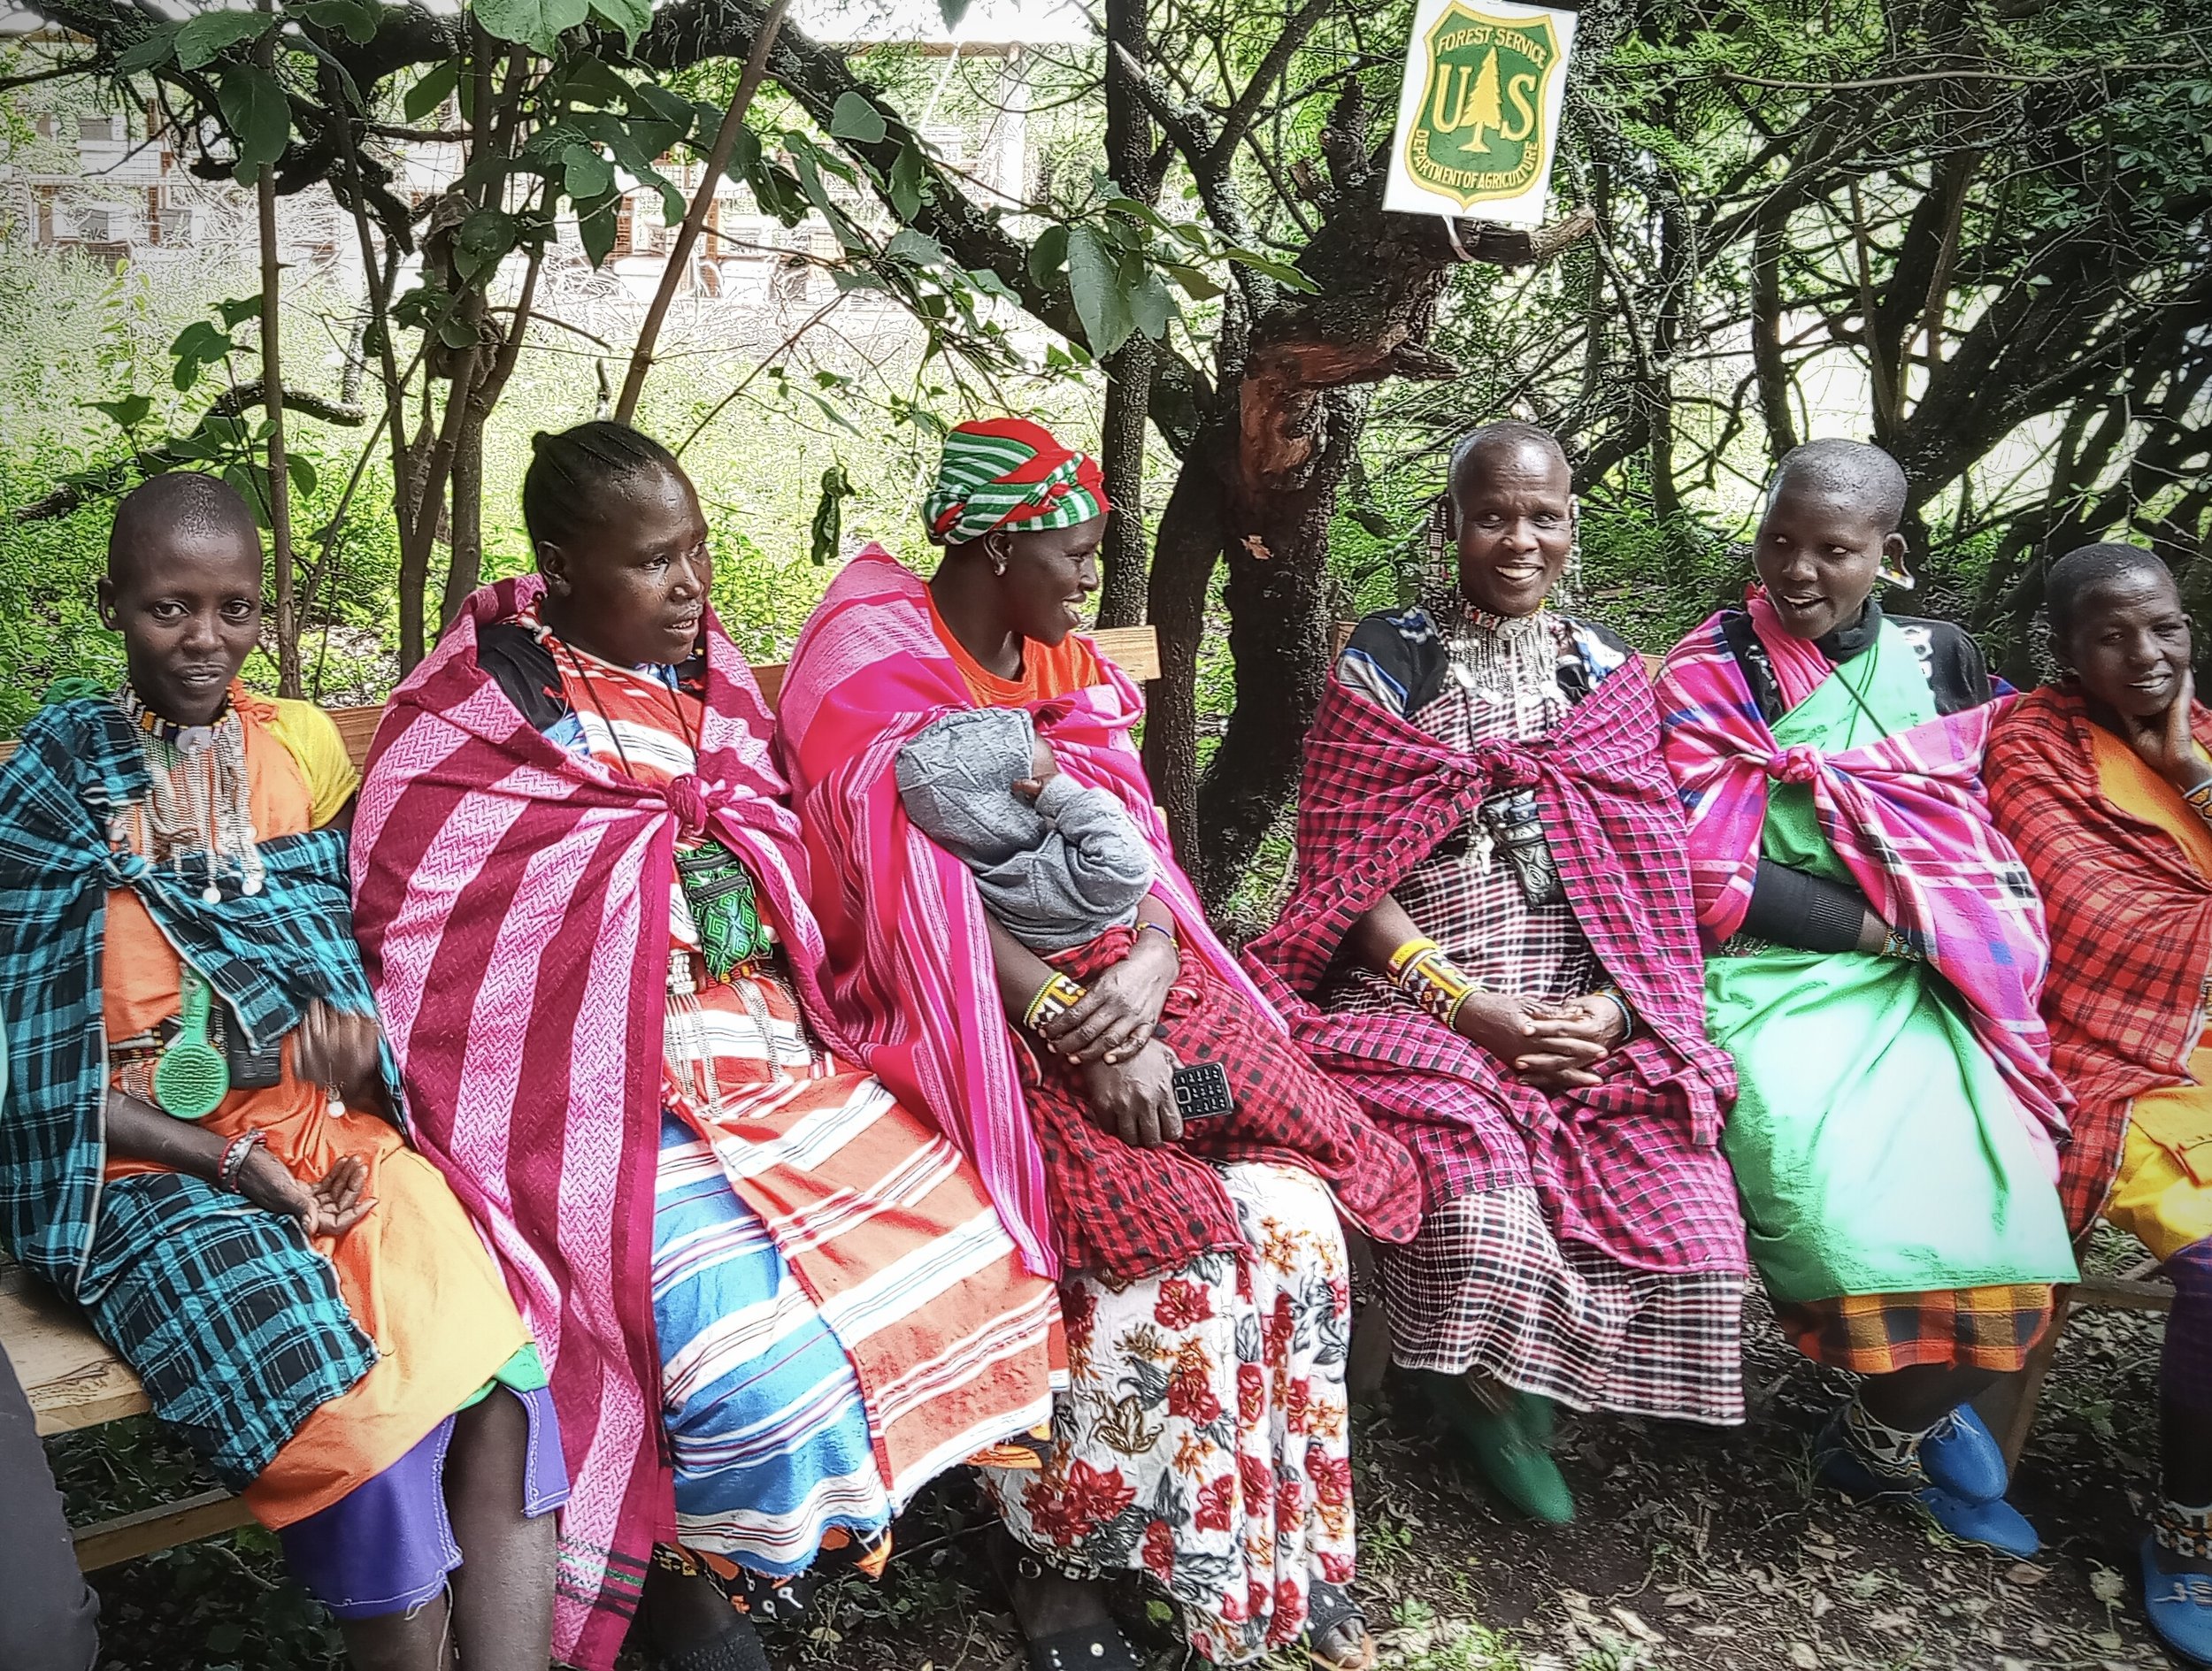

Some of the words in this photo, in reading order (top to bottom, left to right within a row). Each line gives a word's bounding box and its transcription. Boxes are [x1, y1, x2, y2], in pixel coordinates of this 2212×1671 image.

[1436, 27, 1494, 57] FOREST
[1494, 27, 1548, 69] SERVICE
[1432, 64, 1473, 134] U
[1501, 73, 1538, 142] S
[1413, 129, 1464, 187] DEPARTMENT
[1463, 171, 1479, 188] OF
[1477, 141, 1539, 188] AGRICULTURE
